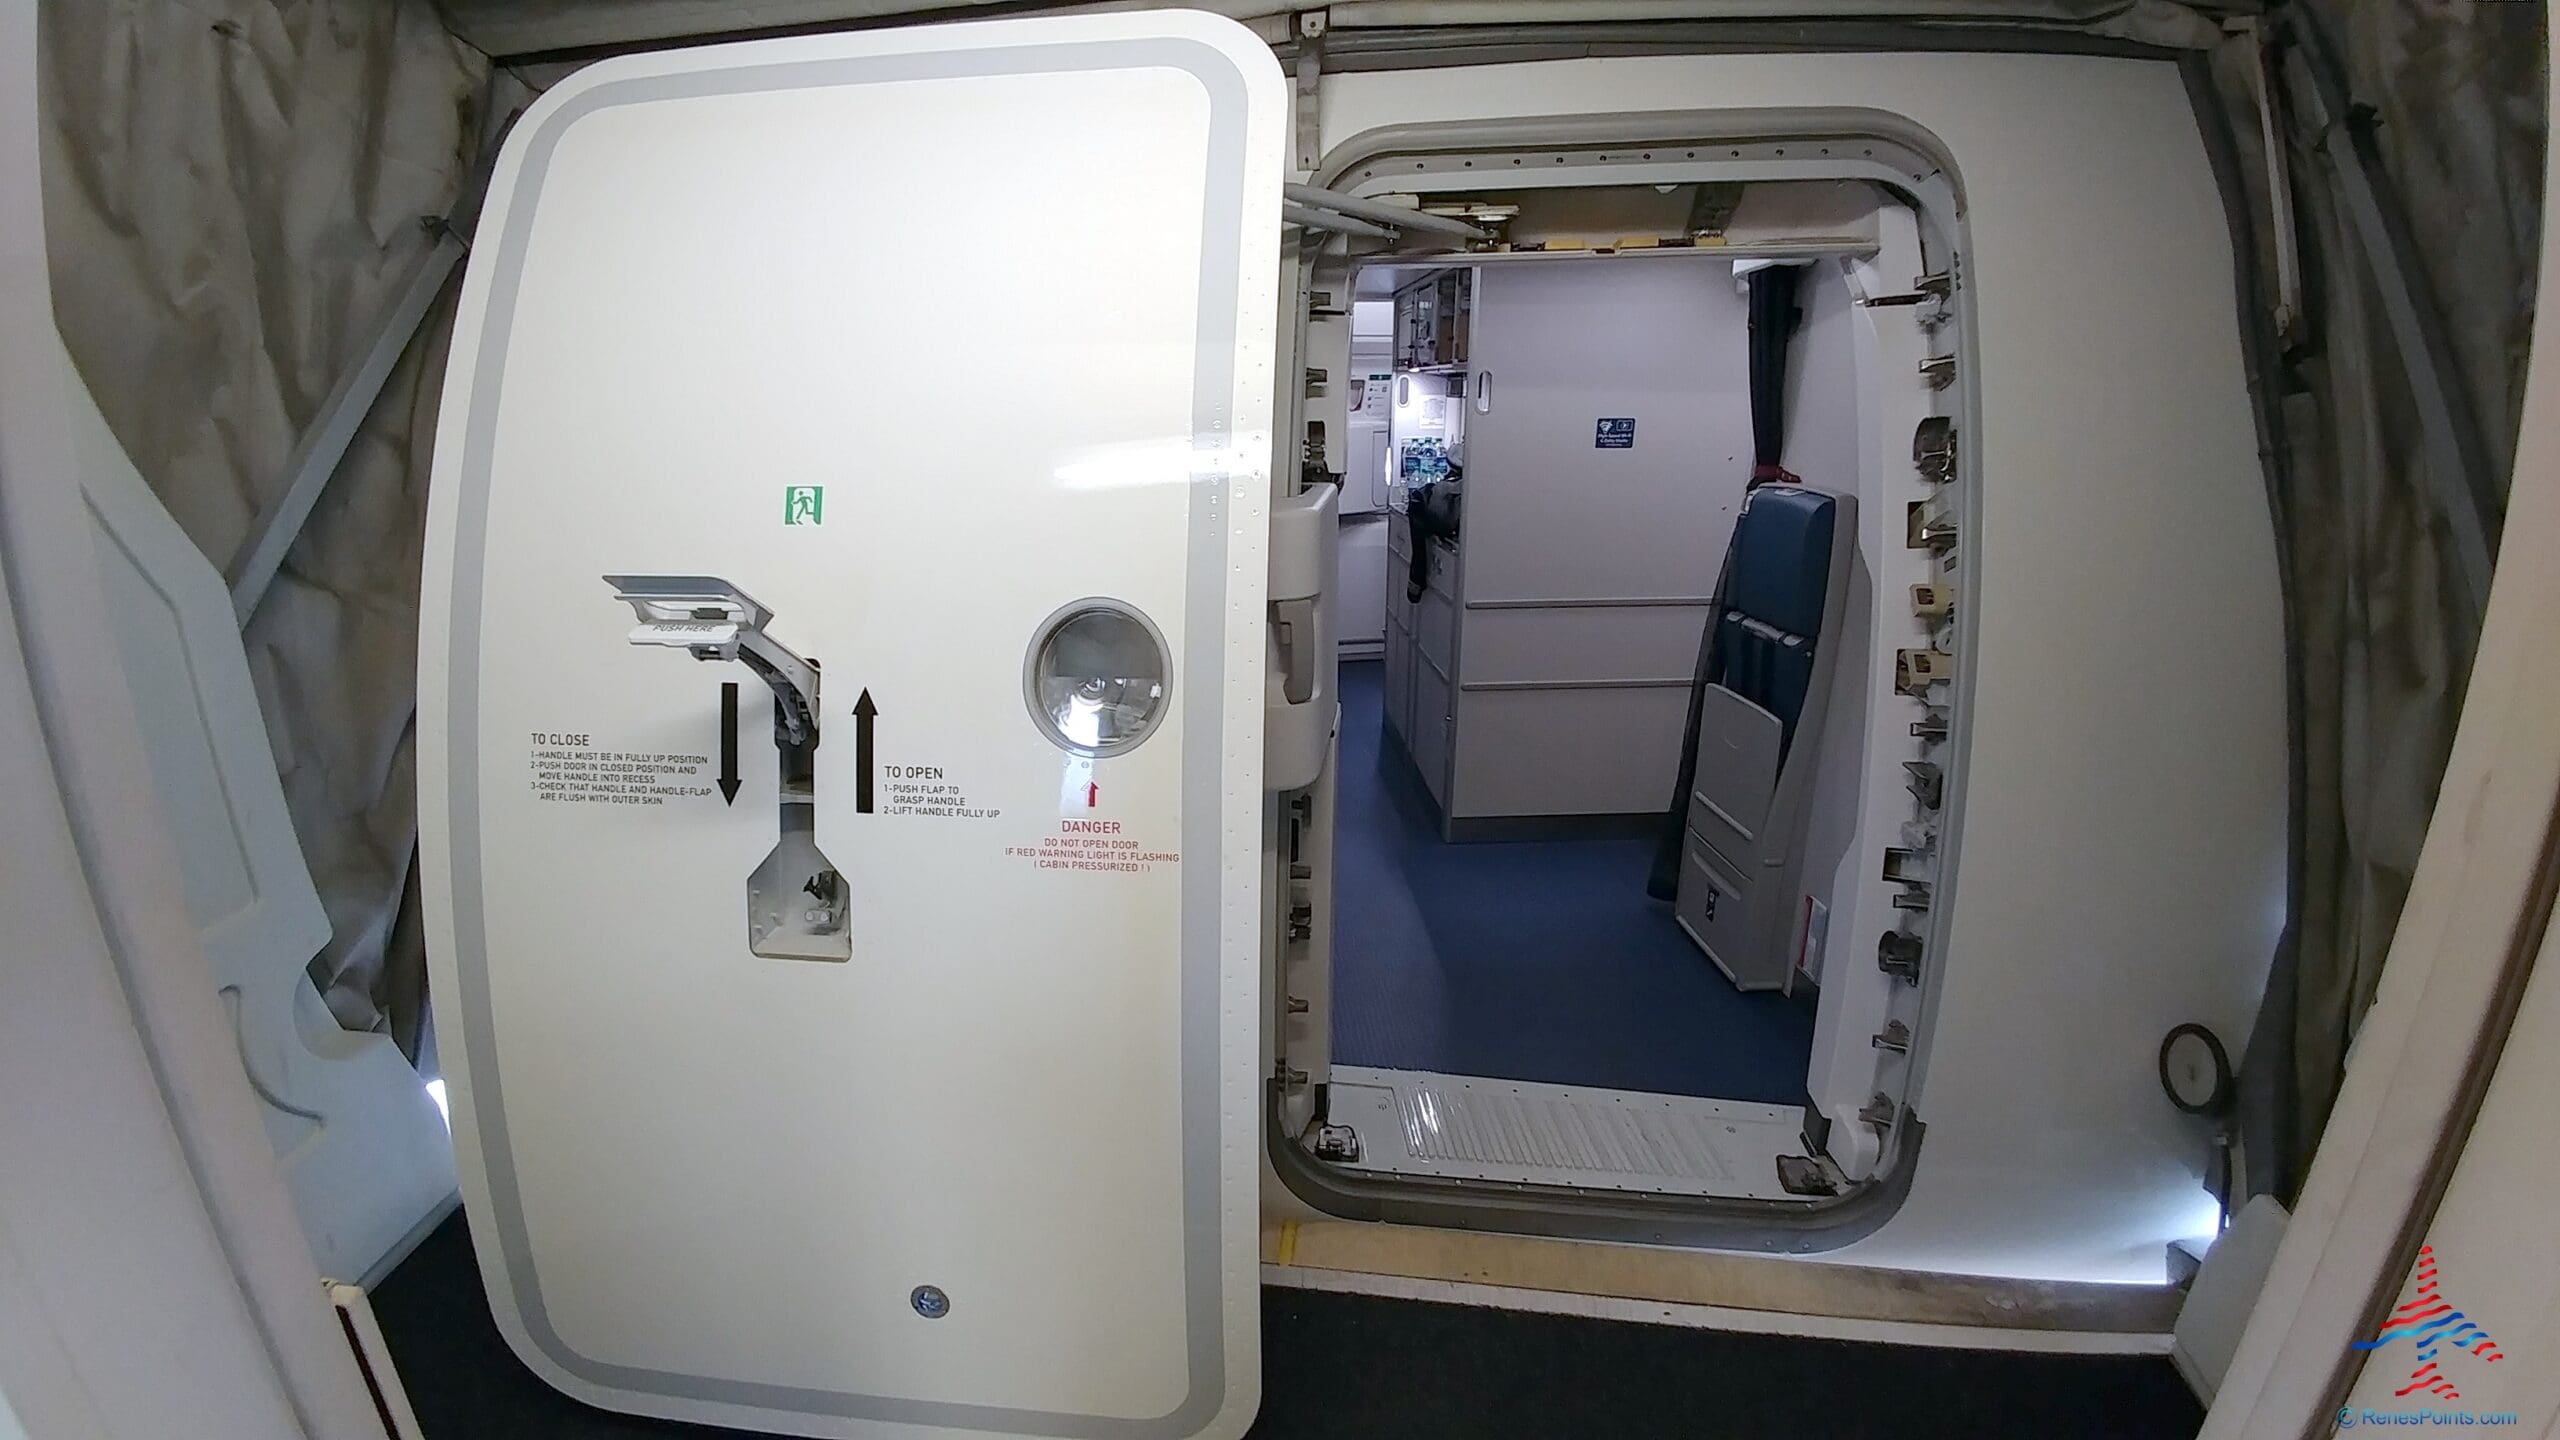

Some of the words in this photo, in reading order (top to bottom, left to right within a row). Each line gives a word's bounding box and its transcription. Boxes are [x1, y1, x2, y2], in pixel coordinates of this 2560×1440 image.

[653, 624, 684, 632] PUSH
[684, 624, 716, 632] HERE
[531, 733, 546, 745] TO
[550, 734, 590, 746] CLOSE
[575, 752, 598, 760] MUST
[600, 752, 612, 760] BE
[626, 754, 651, 762] FULLY
[654, 754, 665, 762] UP
[668, 755, 708, 764] POSITION
[564, 762, 586, 770] DOOR
[589, 763, 598, 771] IN
[600, 764, 633, 772] CLOSED
[636, 764, 675, 774] POSITION
[678, 766, 696, 774] AND
[884, 766, 901, 778] TO
[906, 766, 942, 779] OPEN
[540, 772, 562, 780] MOVE
[564, 773, 598, 782] HANDLE
[600, 774, 620, 782] INTO
[623, 775, 656, 784] RECESS
[569, 783, 590, 791] THAT
[592, 784, 626, 794] HANDLE
[629, 786, 647, 794] AND
[650, 786, 712, 796] HANDLE-FLAP
[884, 784, 918, 793] 1-PUSH
[921, 785, 945, 794] FLAP
[948, 786, 959, 794] TO
[540, 792, 556, 801] ARE
[558, 794, 586, 802] FLUSH
[612, 796, 640, 804] OUTER
[893, 796, 924, 804] GRASP
[928, 796, 966, 806] HANDLE
[884, 806, 912, 815] 2-LIFT
[916, 808, 953, 816] HANDLE
[956, 808, 985, 818] FULLY
[987, 810, 1000, 818] UP
[1062, 820, 1120, 834] DANGER
[1044, 838, 1058, 846] DO
[1061, 839, 1079, 848] NOT
[1082, 840, 1108, 848] OPEN
[1112, 840, 1138, 849] DOOR
[1006, 848, 1013, 856] IF
[1016, 848, 1036, 856] RED
[1039, 848, 1084, 858] WARNING
[1087, 850, 1115, 860] LIGHT
[1118, 852, 1127, 860] IS
[1131, 852, 1180, 862] FLASHING
[1072, 861, 1138, 872] PRESSURIZED
